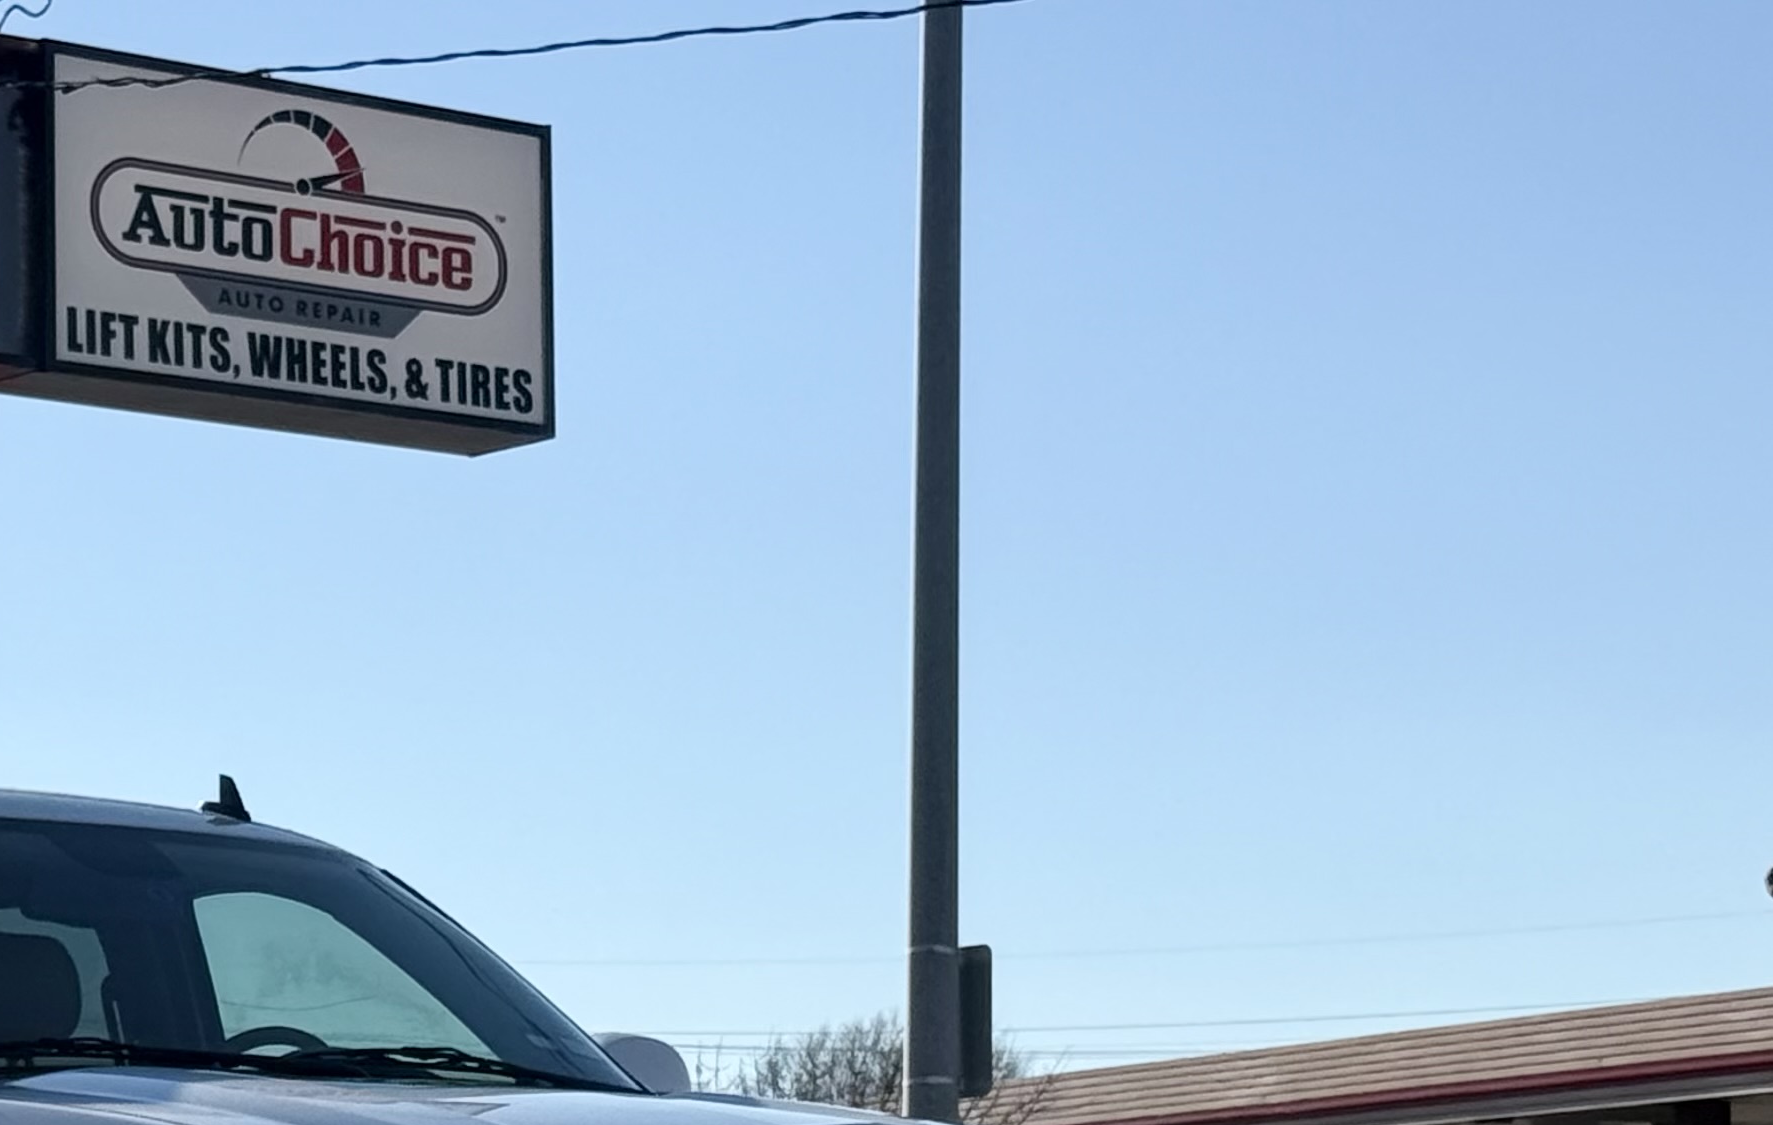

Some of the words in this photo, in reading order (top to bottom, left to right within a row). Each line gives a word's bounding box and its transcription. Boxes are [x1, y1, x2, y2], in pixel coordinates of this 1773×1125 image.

[218, 287, 285, 313] AUTO
[296, 300, 382, 327] REPAIR
[66, 306, 139, 361] LIFT
[148, 318, 241, 379] KITS,
[247, 331, 398, 401] WHEELS,
[405, 358, 430, 401] &
[435, 358, 534, 415] TIRES
